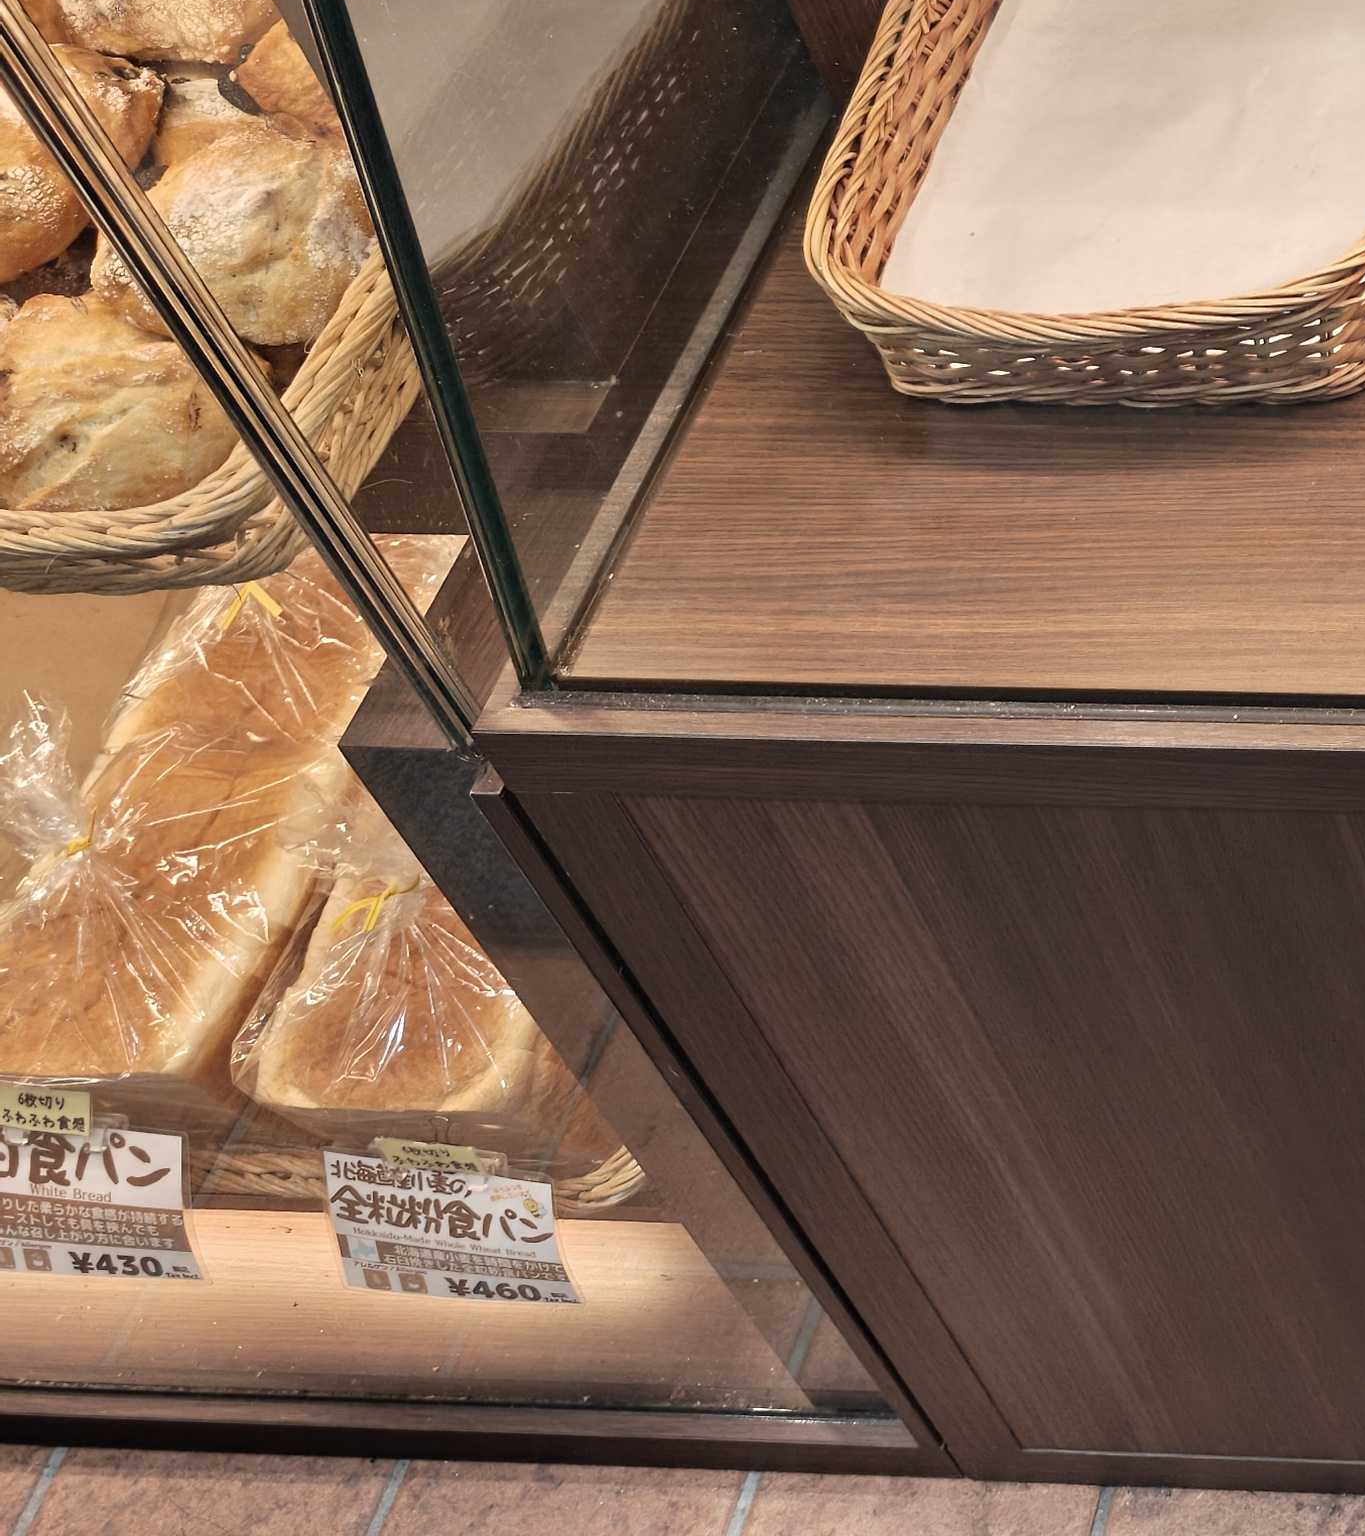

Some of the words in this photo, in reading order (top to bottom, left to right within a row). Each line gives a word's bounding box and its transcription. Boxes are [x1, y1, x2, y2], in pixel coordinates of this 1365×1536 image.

[31, 1183, 67, 1198] White
[73, 1187, 112, 1203] Bread
[68, 1251, 163, 1276] ¥430
[444, 1276, 542, 1301] ¥460
